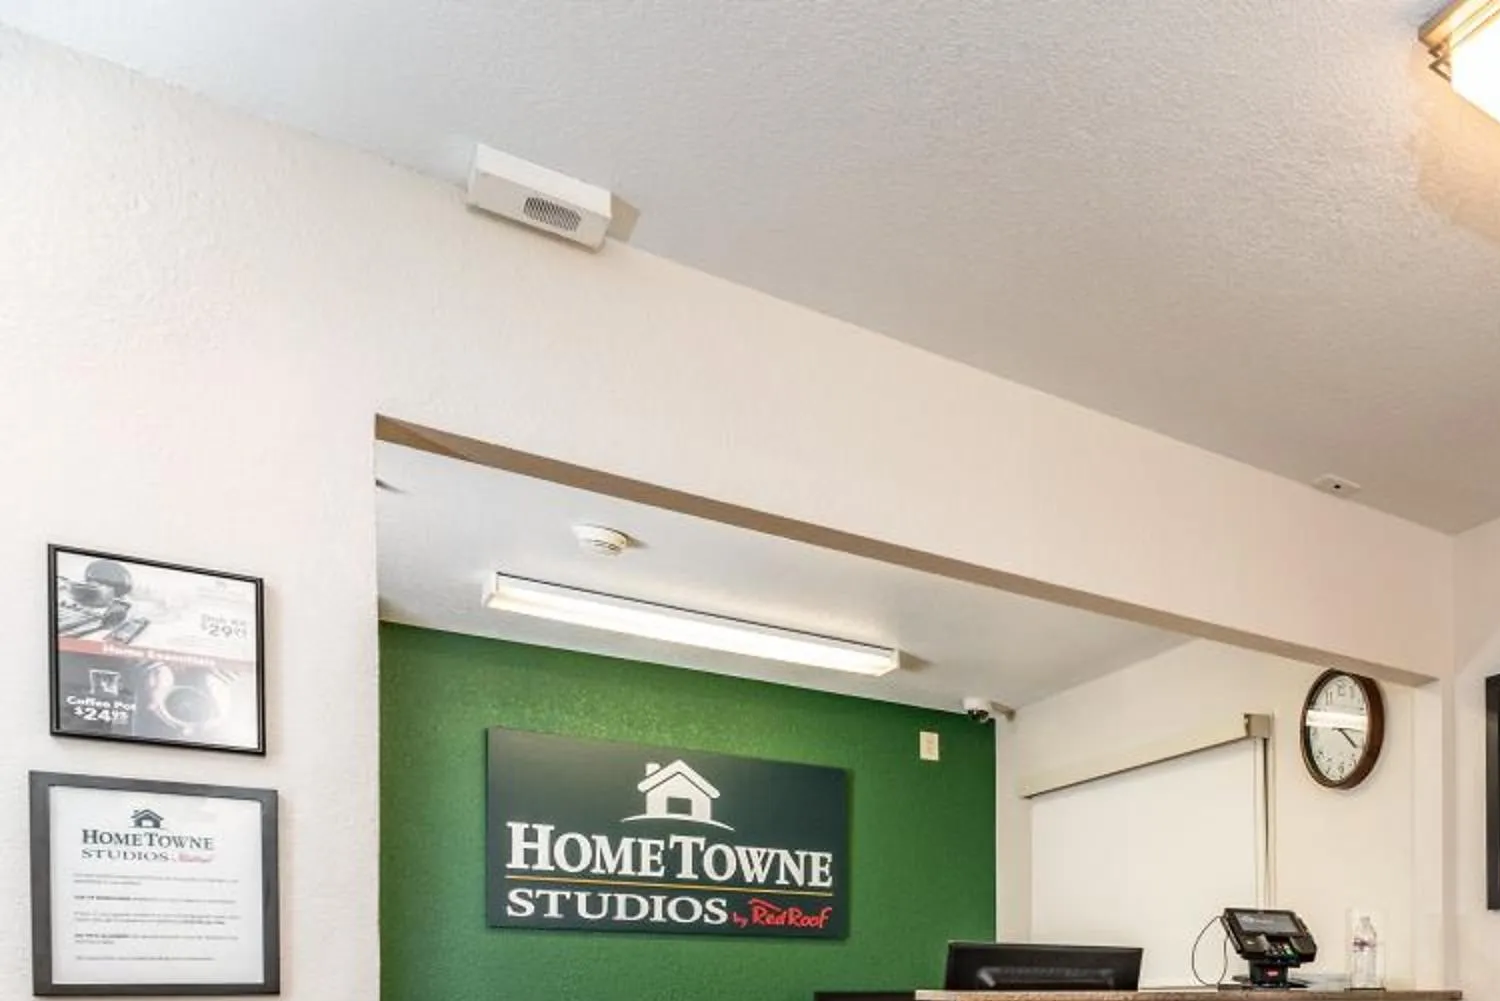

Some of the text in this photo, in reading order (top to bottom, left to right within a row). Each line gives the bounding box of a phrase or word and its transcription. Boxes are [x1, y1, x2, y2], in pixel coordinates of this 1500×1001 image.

[81, 848, 169, 862] STUDIOS
[506, 888, 728, 925] STUDIOS
[732, 911, 749, 929] by
